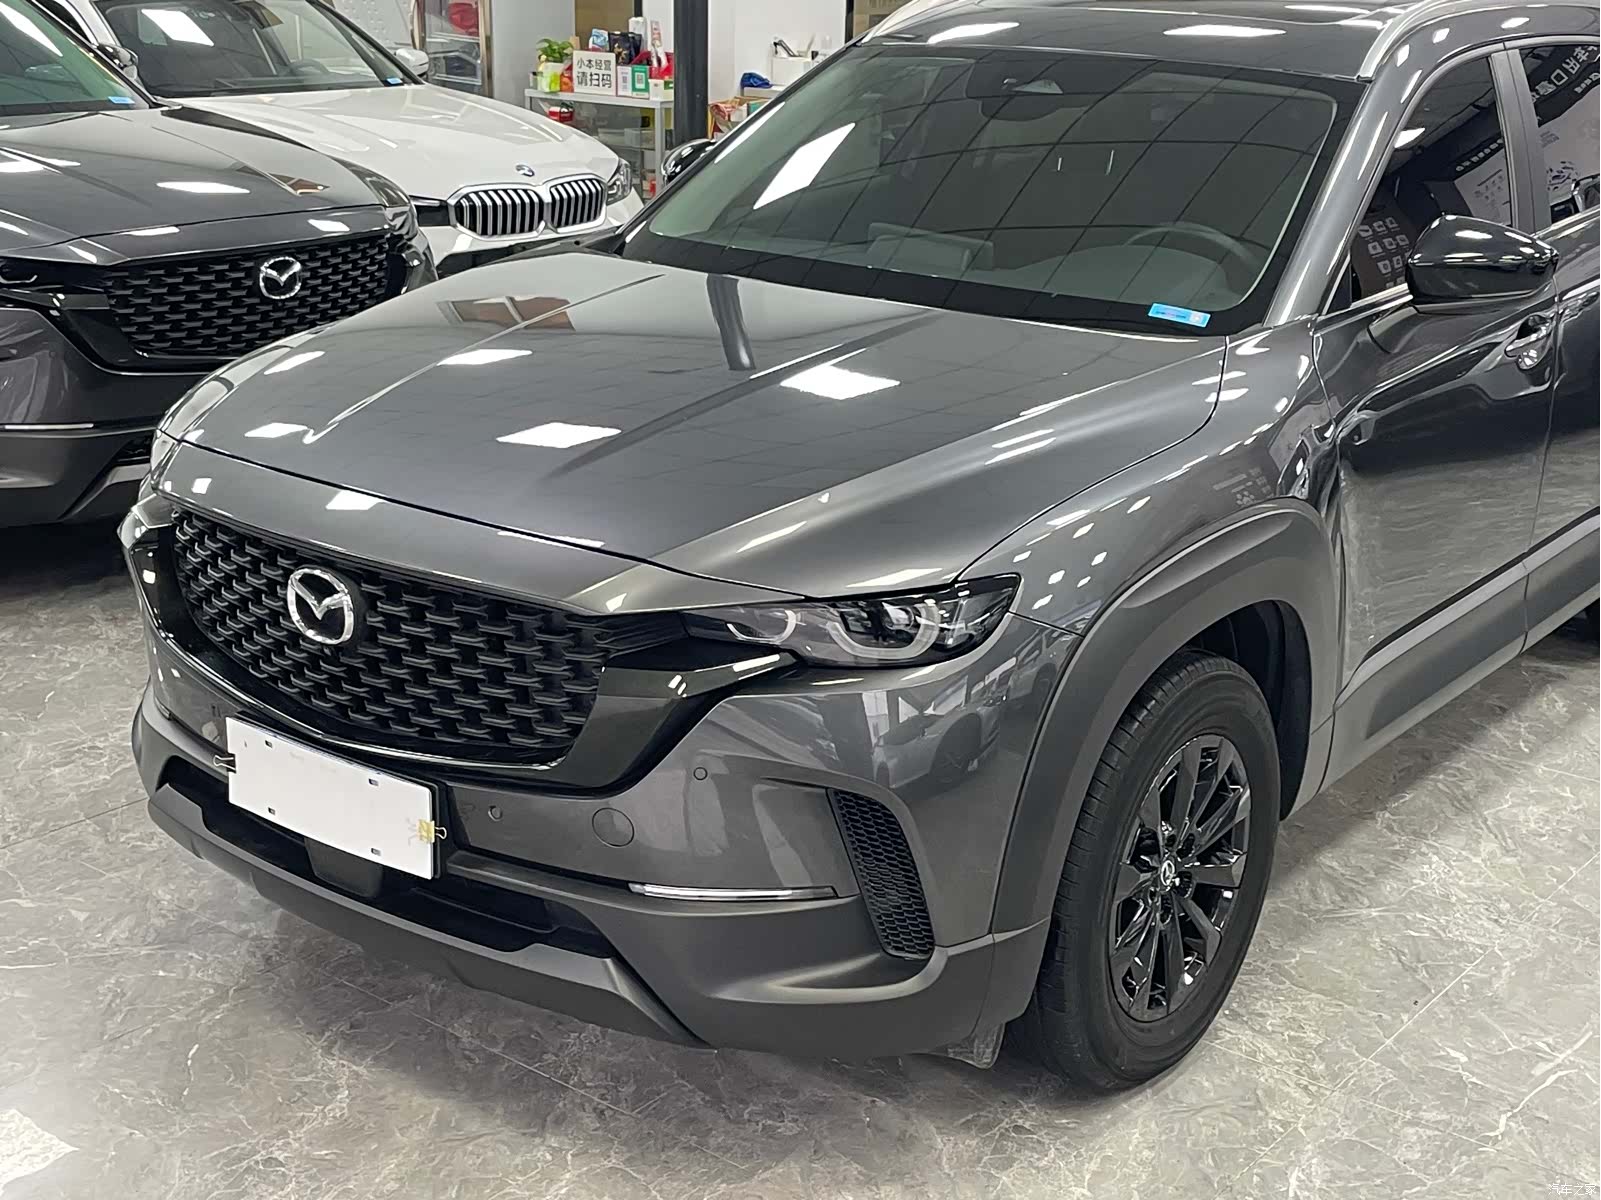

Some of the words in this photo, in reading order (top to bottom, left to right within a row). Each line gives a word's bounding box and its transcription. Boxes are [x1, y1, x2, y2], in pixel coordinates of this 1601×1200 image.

[577, 57, 611, 71] 小本经营
[577, 71, 612, 88] 请扫码
